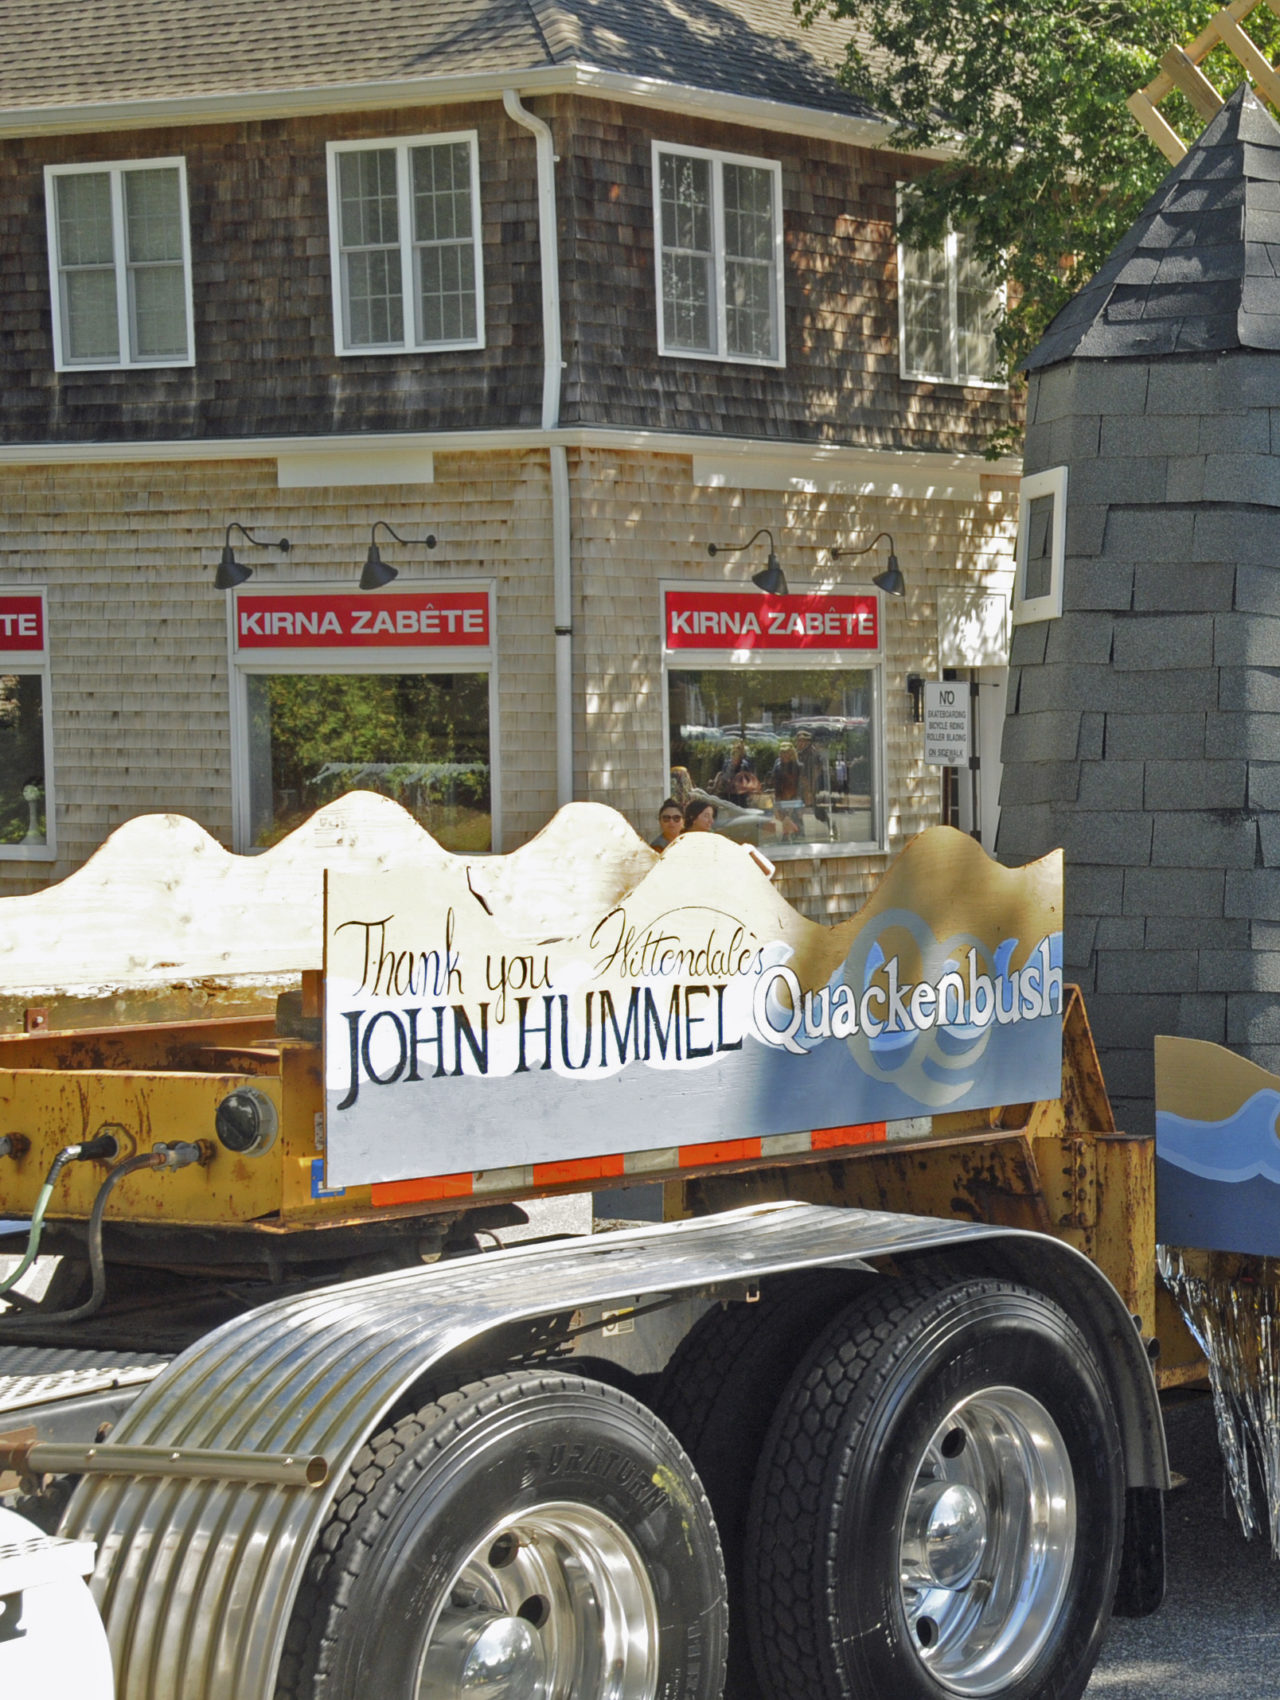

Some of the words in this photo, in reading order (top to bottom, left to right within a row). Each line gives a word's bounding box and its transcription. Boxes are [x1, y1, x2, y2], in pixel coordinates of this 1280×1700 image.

[240, 611, 343, 635] KIRNA
[350, 603, 484, 634] ZABÊTE
[671, 611, 762, 635] KIRNA
[768, 606, 874, 635] ZABÊTE
[939, 690, 955, 705] NO
[927, 710, 966, 719] SKATEBOARDING
[928, 722, 948, 730] BICYCLE
[949, 722, 965, 730] RIDING
[927, 733, 945, 741] ROLLER
[946, 733, 966, 742] BLADING
[928, 748, 936, 756] ON
[937, 748, 963, 757] SIDEWALK
[334, 907, 465, 998] Thank
[486, 952, 554, 1025] you
[753, 935, 1064, 1055] Quackenbush
[336, 1001, 491, 1111] JOHN
[513, 983, 743, 1073] HUMMEL
